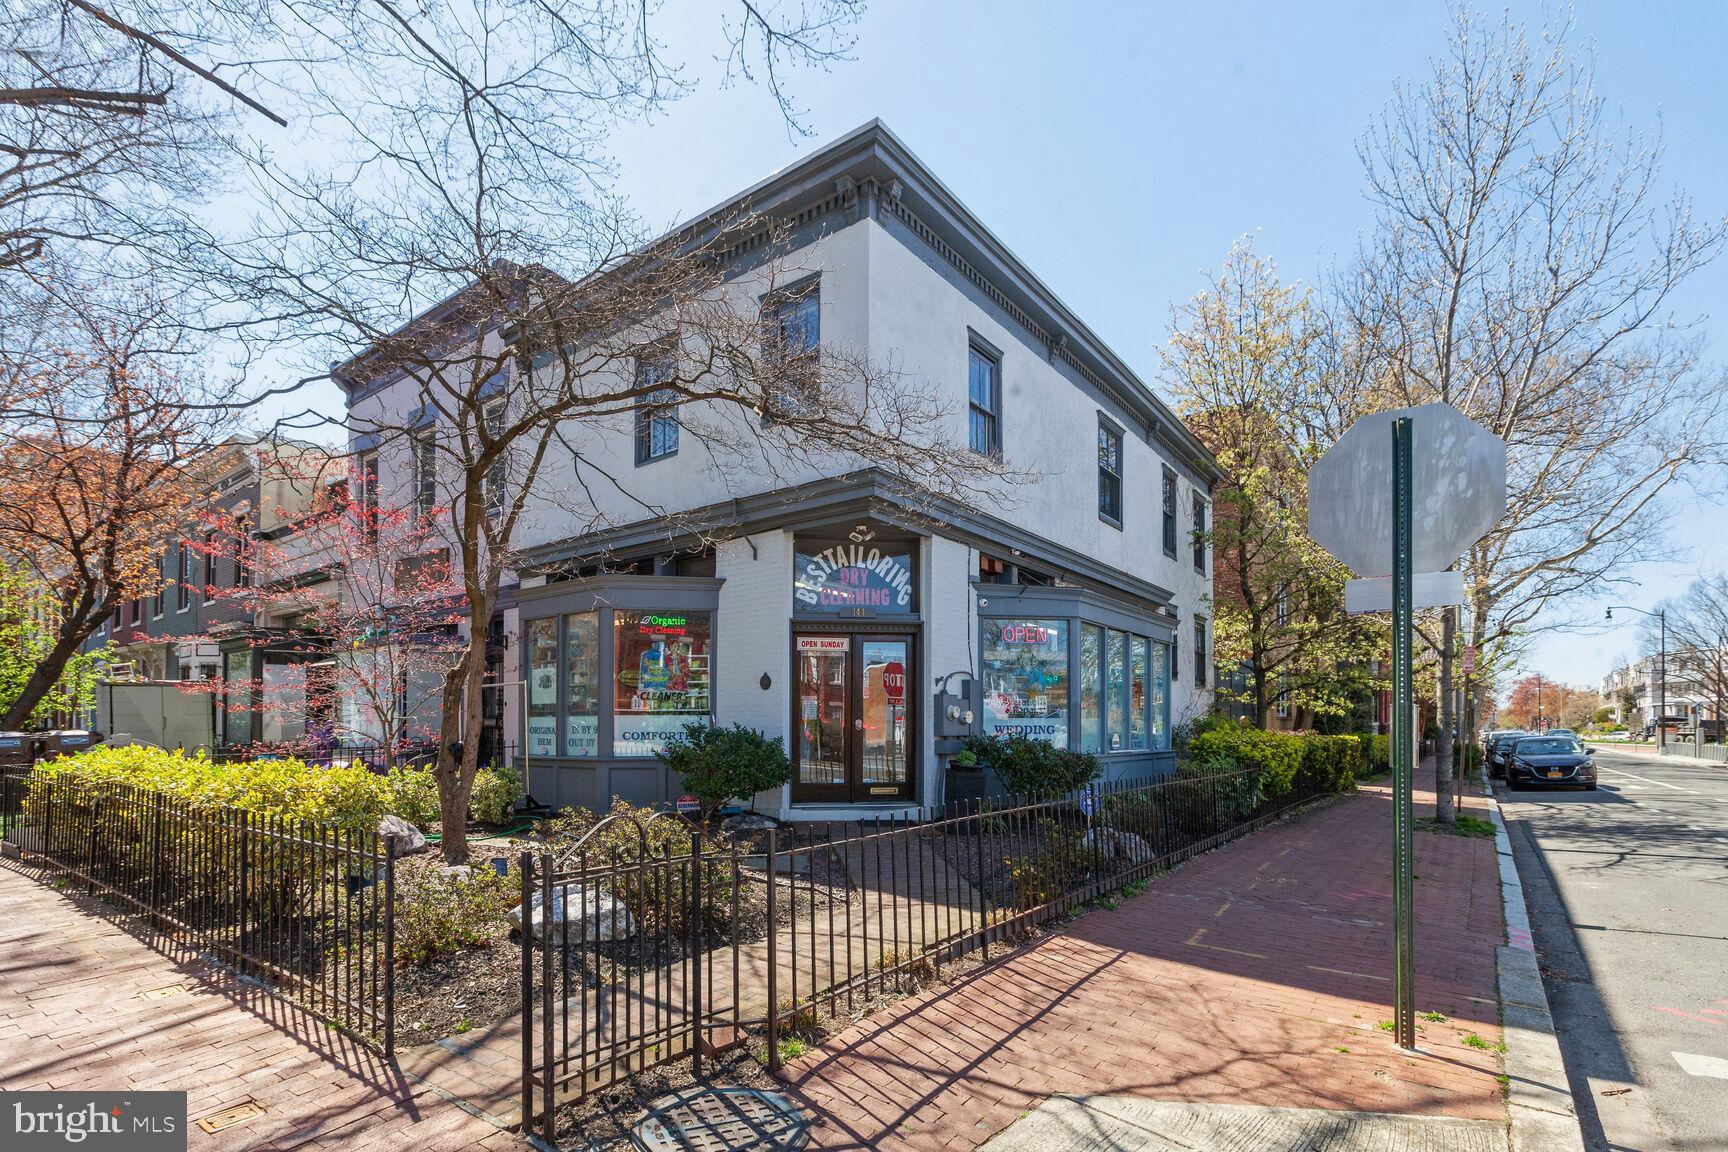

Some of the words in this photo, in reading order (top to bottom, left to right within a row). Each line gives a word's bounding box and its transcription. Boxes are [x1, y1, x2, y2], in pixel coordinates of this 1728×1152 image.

[795, 553, 832, 605] BEST
[823, 545, 912, 605] TAILORING
[840, 567, 869, 586] DRY
[820, 588, 890, 606] CLEANING
[651, 616, 686, 627] Organic
[640, 626, 654, 635] Dry
[655, 626, 686, 636] Cleaning
[1003, 626, 1047, 643] OPEN
[801, 640, 818, 648] OPEN
[820, 641, 845, 649] SUNDAY
[640, 691, 688, 701] CLEANERS
[529, 726, 557, 735] ORIGINA
[994, 724, 1056, 736] WEDDING
[537, 738, 552, 746] HEM
[568, 738, 583, 747] OUT
